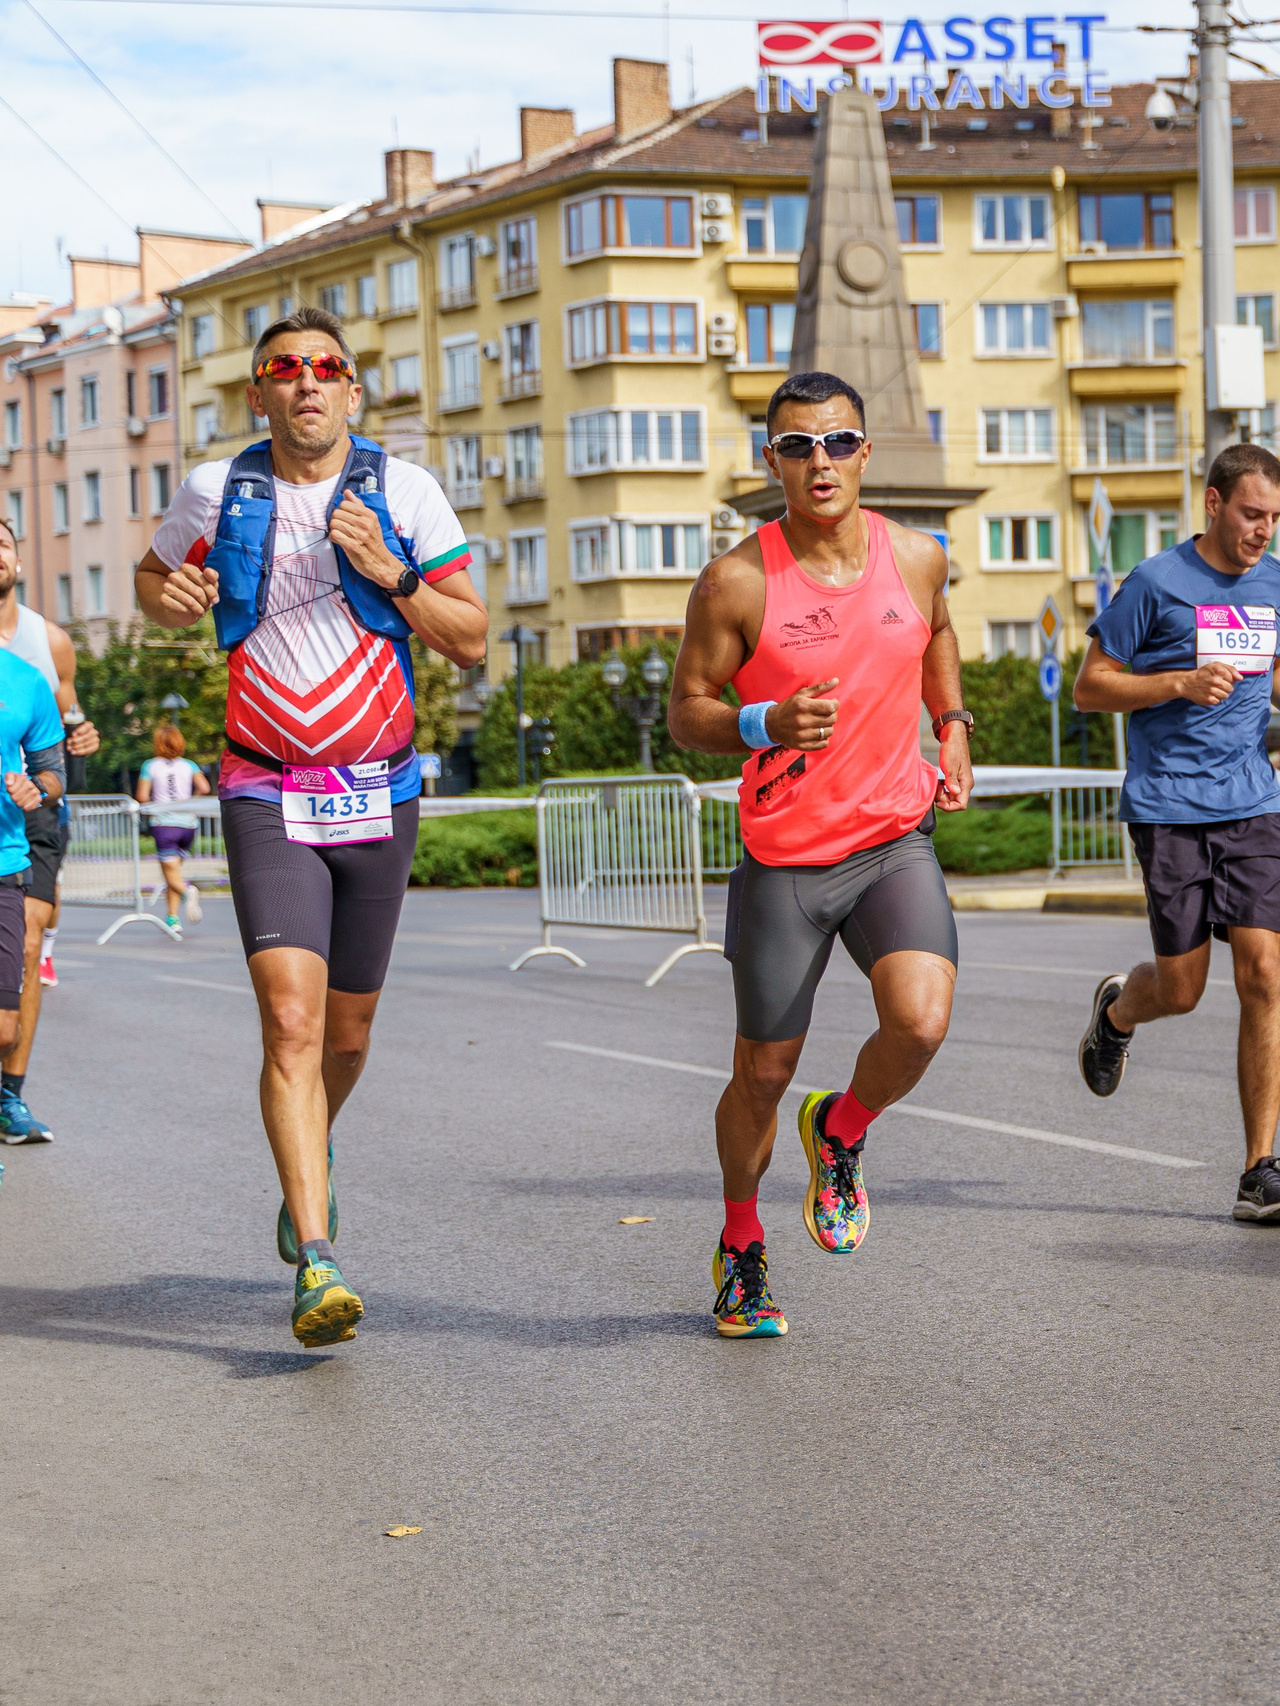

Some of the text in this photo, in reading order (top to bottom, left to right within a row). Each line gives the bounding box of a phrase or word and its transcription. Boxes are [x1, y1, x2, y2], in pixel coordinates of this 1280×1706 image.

[893, 15, 1105, 62] ASSET
[1216, 632, 1261, 649] 1692
[307, 794, 369, 817] 1433
